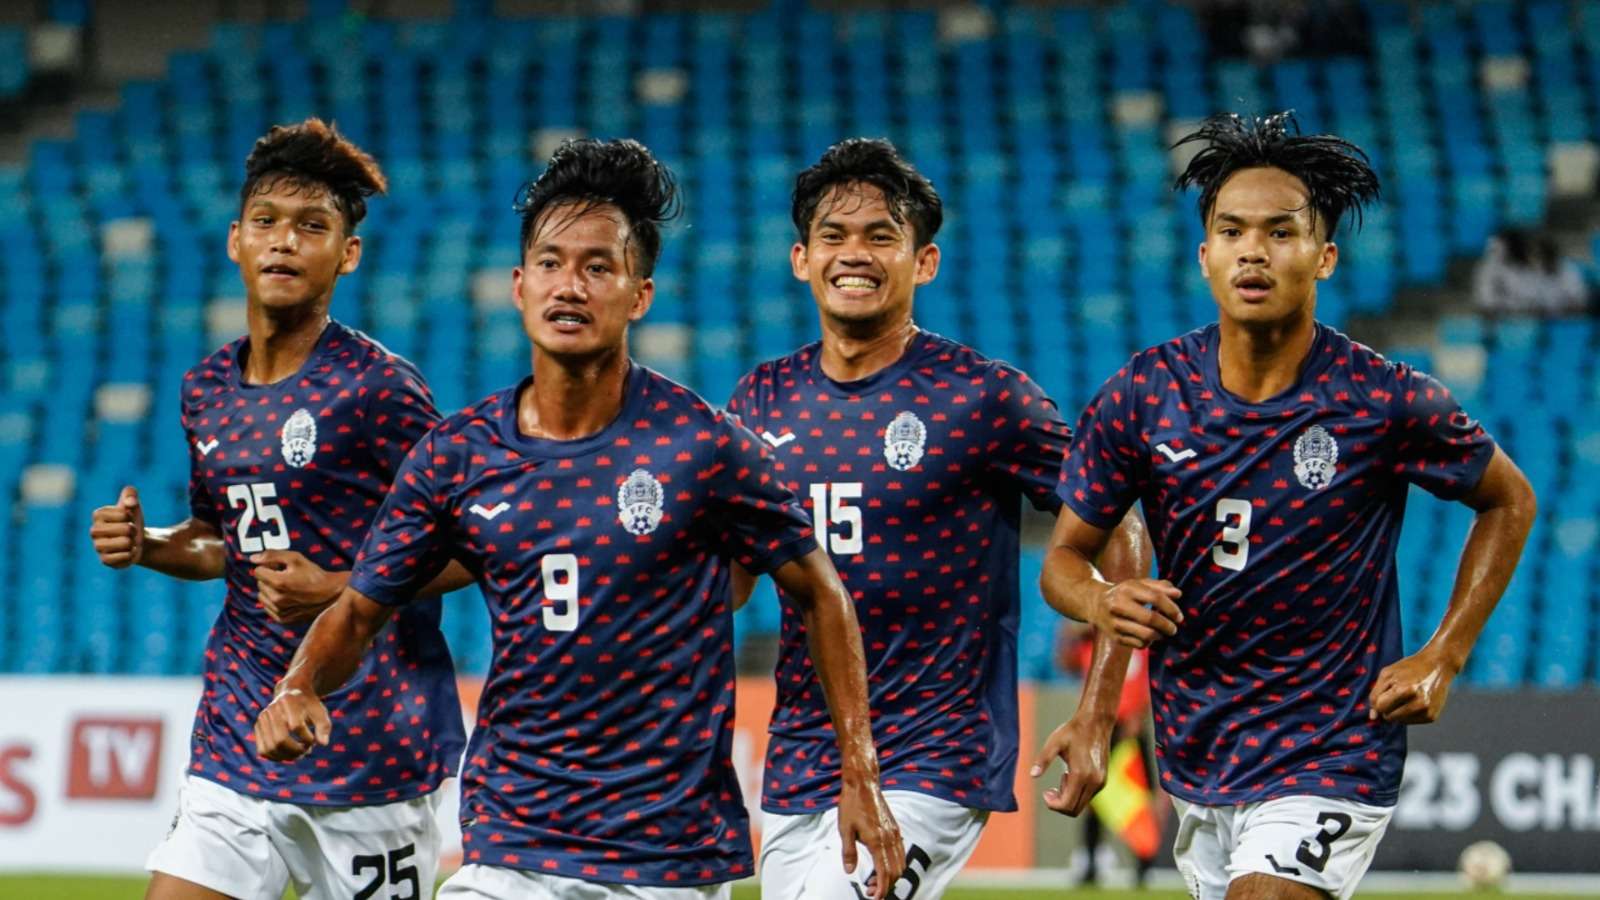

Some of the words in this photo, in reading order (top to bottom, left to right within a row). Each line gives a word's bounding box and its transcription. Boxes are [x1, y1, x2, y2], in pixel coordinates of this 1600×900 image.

[1305, 459, 1327, 470] FFC
[227, 482, 291, 553] 25
[630, 504, 653, 515] FFC
[809, 482, 863, 555] 15
[1212, 498, 1252, 571] 3
[541, 553, 579, 631] 9
[79, 725, 156, 788] TV
[1489, 752, 1600, 832] CH
[352, 842, 420, 900] 25
[1296, 811, 1352, 873] 3
